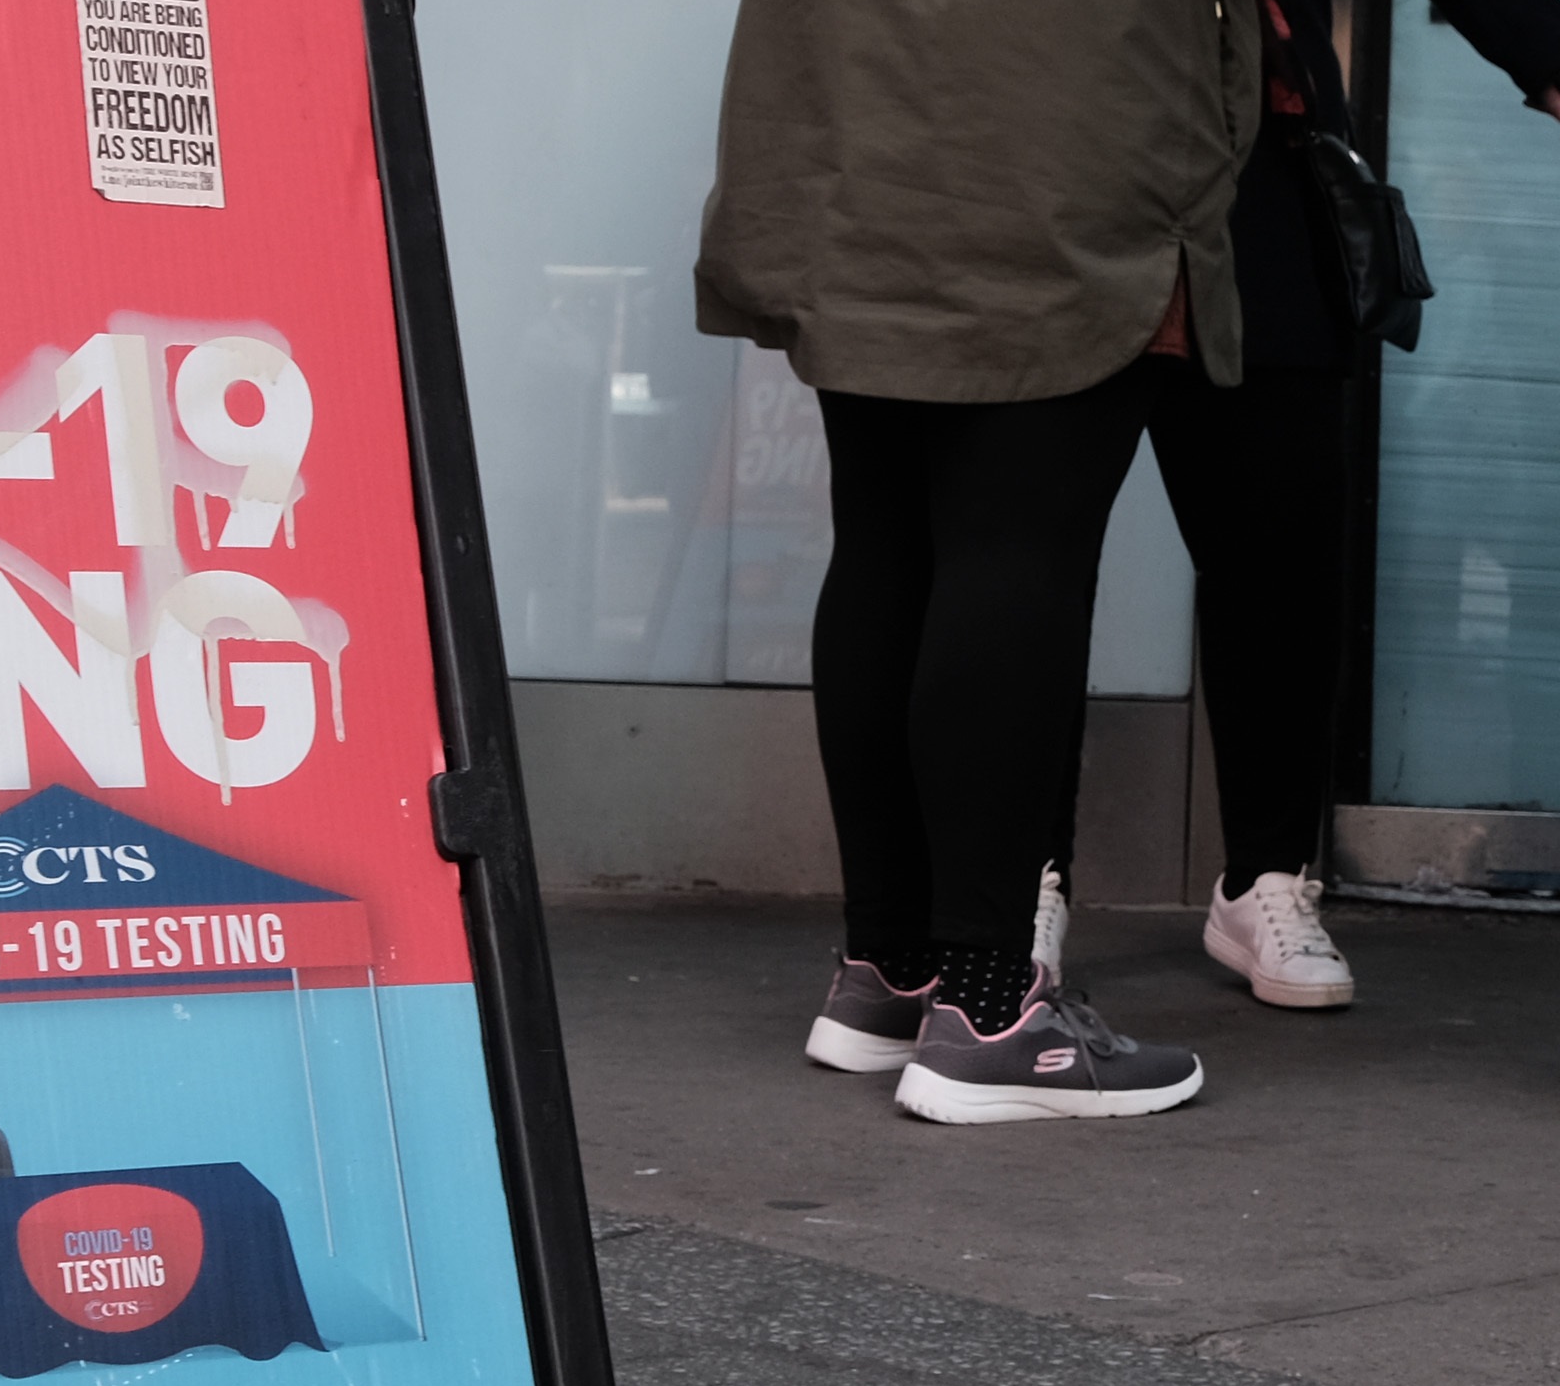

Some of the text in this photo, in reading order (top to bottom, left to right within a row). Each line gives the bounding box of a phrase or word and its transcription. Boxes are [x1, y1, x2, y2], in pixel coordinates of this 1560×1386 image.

[119, 0, 153, 24] ARE
[156, 4, 203, 28] BEING
[86, 25, 205, 60] CONDITIONED
[88, 57, 208, 90] TO VIEW YOUR
[92, 88, 213, 136] FREEDOM
[97, 133, 216, 167] AS SELFISH
[97, 913, 286, 971] TESTING
[64, 1226, 154, 1257] COVID-19
[57, 1255, 165, 1293] TESTING
